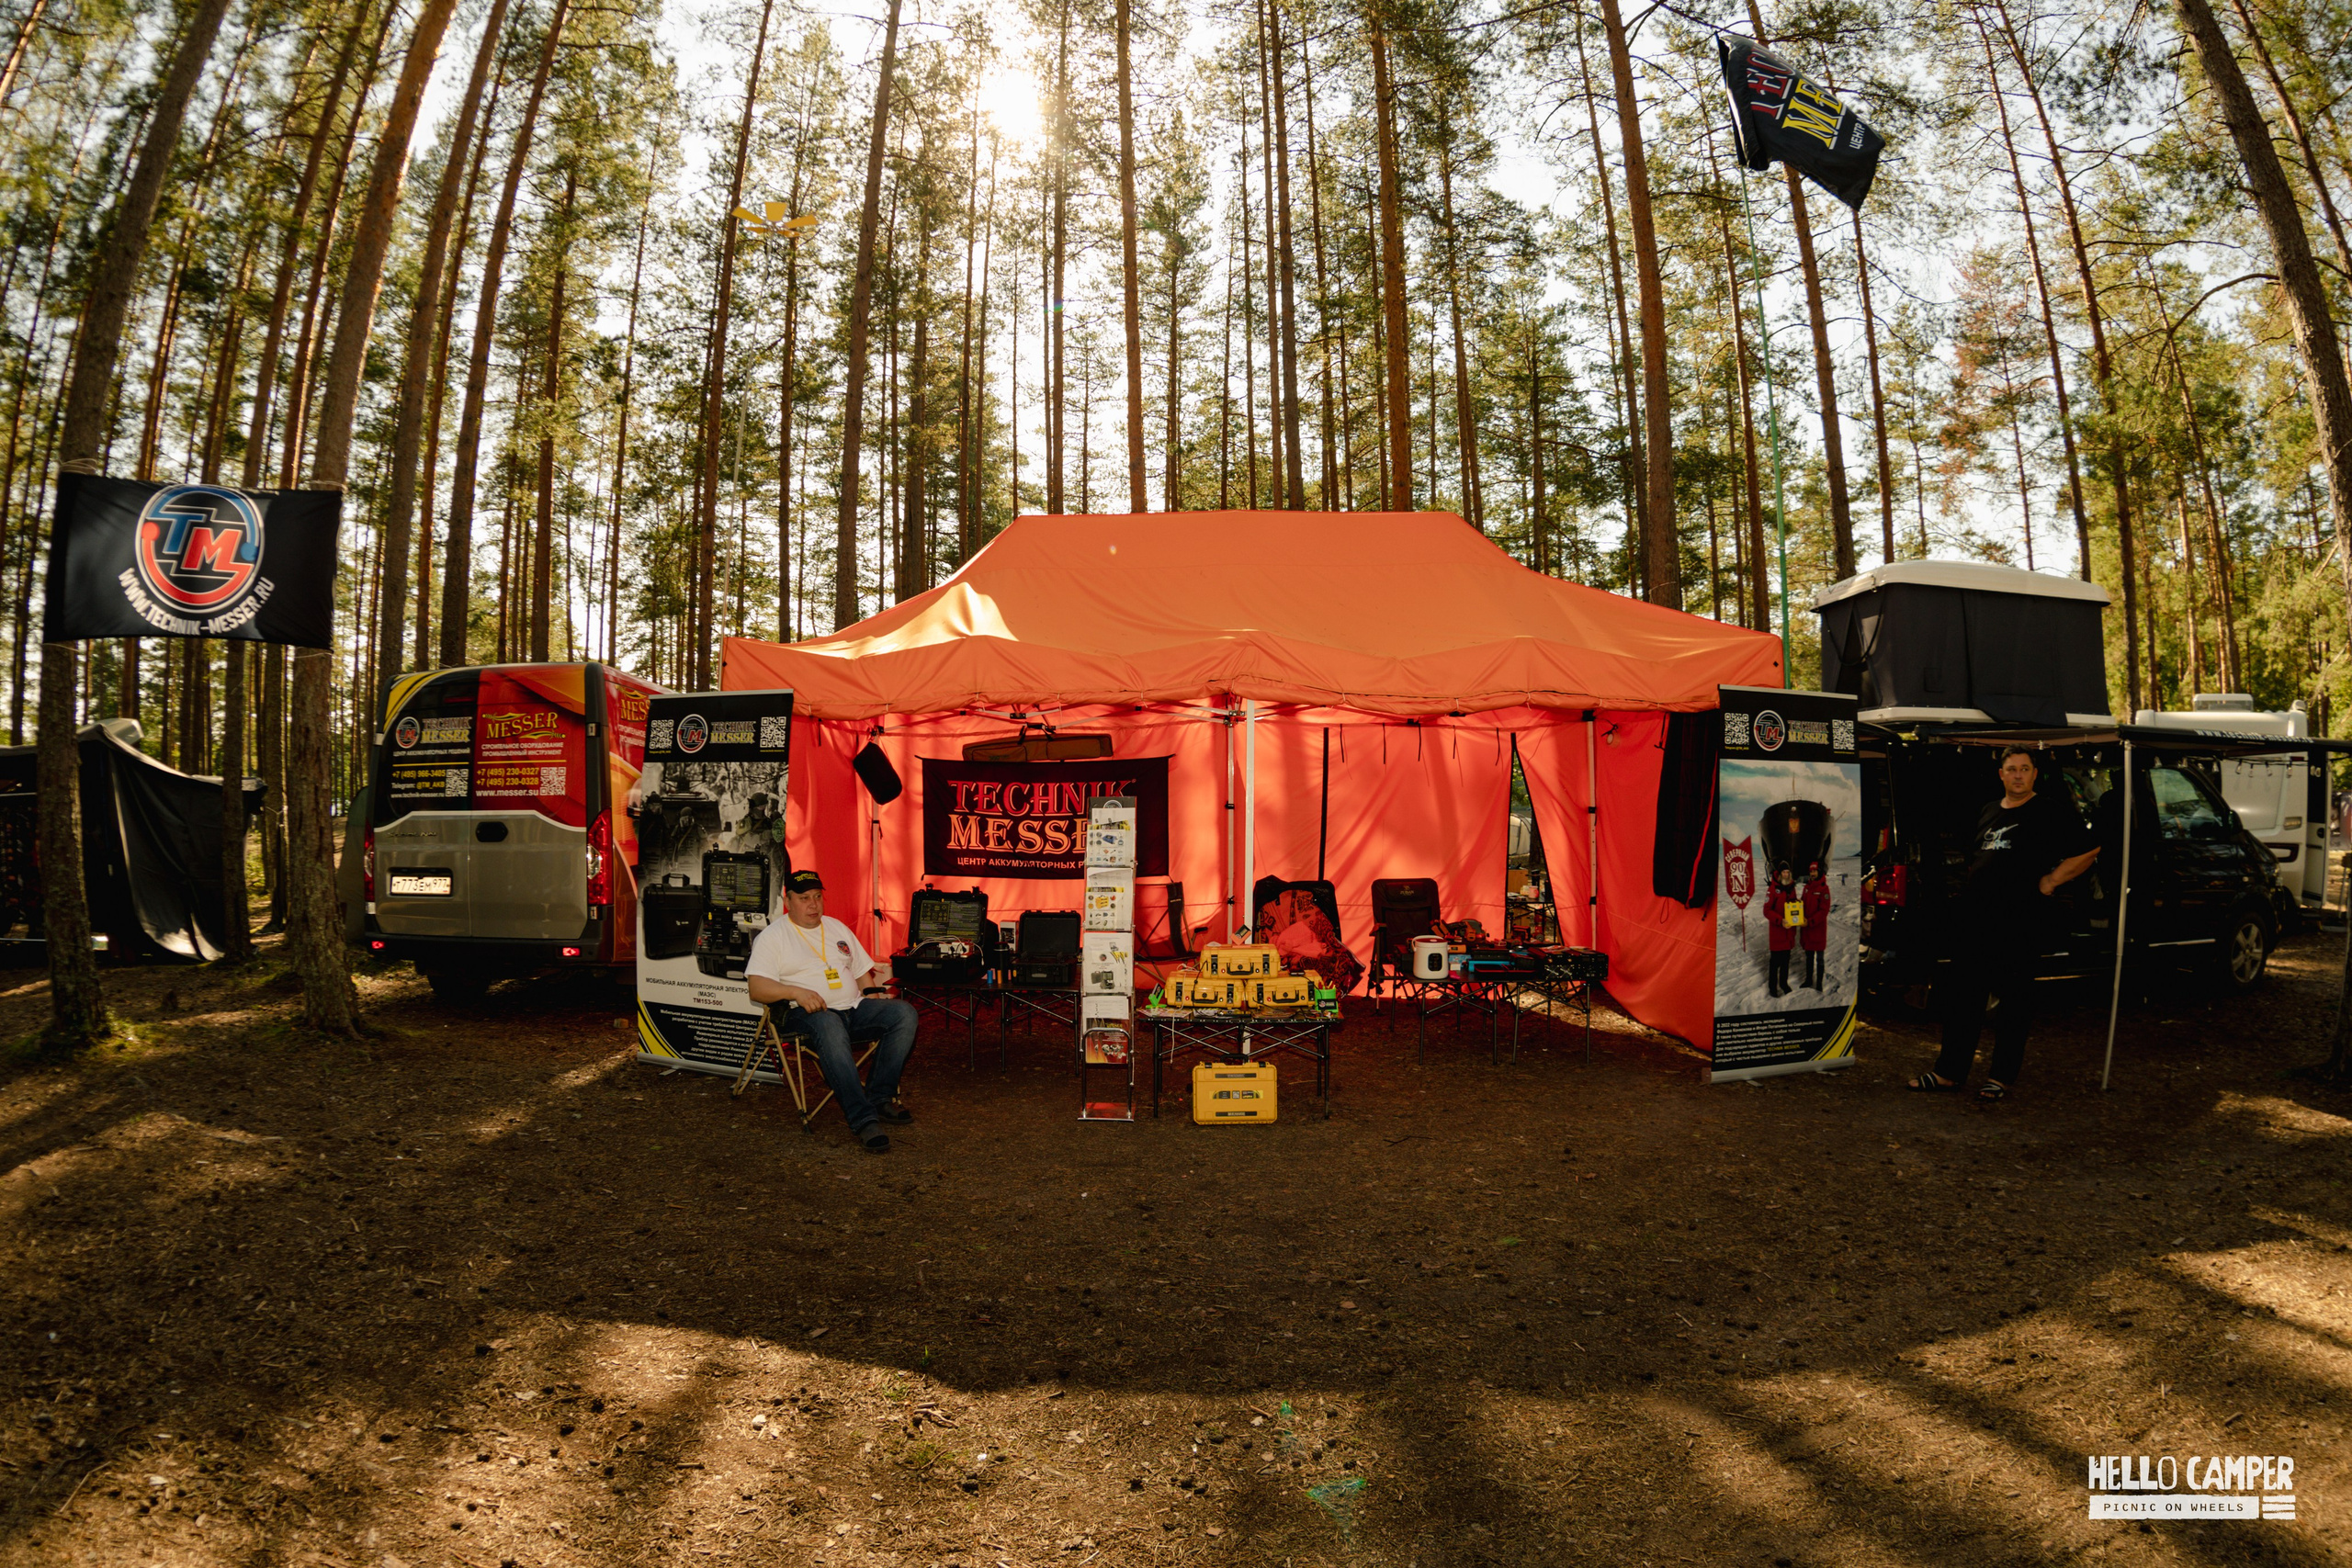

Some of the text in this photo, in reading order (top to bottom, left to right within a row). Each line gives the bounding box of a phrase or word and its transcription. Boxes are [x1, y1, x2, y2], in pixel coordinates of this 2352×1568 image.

[1849, 121, 1866, 150] ЦЕНТР
[118, 566, 276, 636] WWW.TECHNIK-MESSER.RU
[422, 716, 473, 730] TECHNIK
[486, 711, 560, 739] MESSER
[710, 721, 757, 733] TECHNIK
[1787, 719, 1829, 733] TECHNIK
[420, 729, 471, 744] MESSER
[709, 732, 755, 744] MESSER
[1787, 731, 1830, 745] MESSER
[477, 767, 540, 778] +7 (495) 230-0327
[476, 777, 540, 788] +7 (495) 230-0328
[475, 789, 539, 797] www.messer.su
[946, 814, 1088, 854] MESSE
[957, 857, 986, 866] ЦЕНТР
[988, 859, 1076, 869] АККУМУЛЯТОРНЫХ
[645, 976, 749, 994] МОБИЛЬНАЯ АККУМУЛЯТОРНАЯ ЭЛЕКТРО
